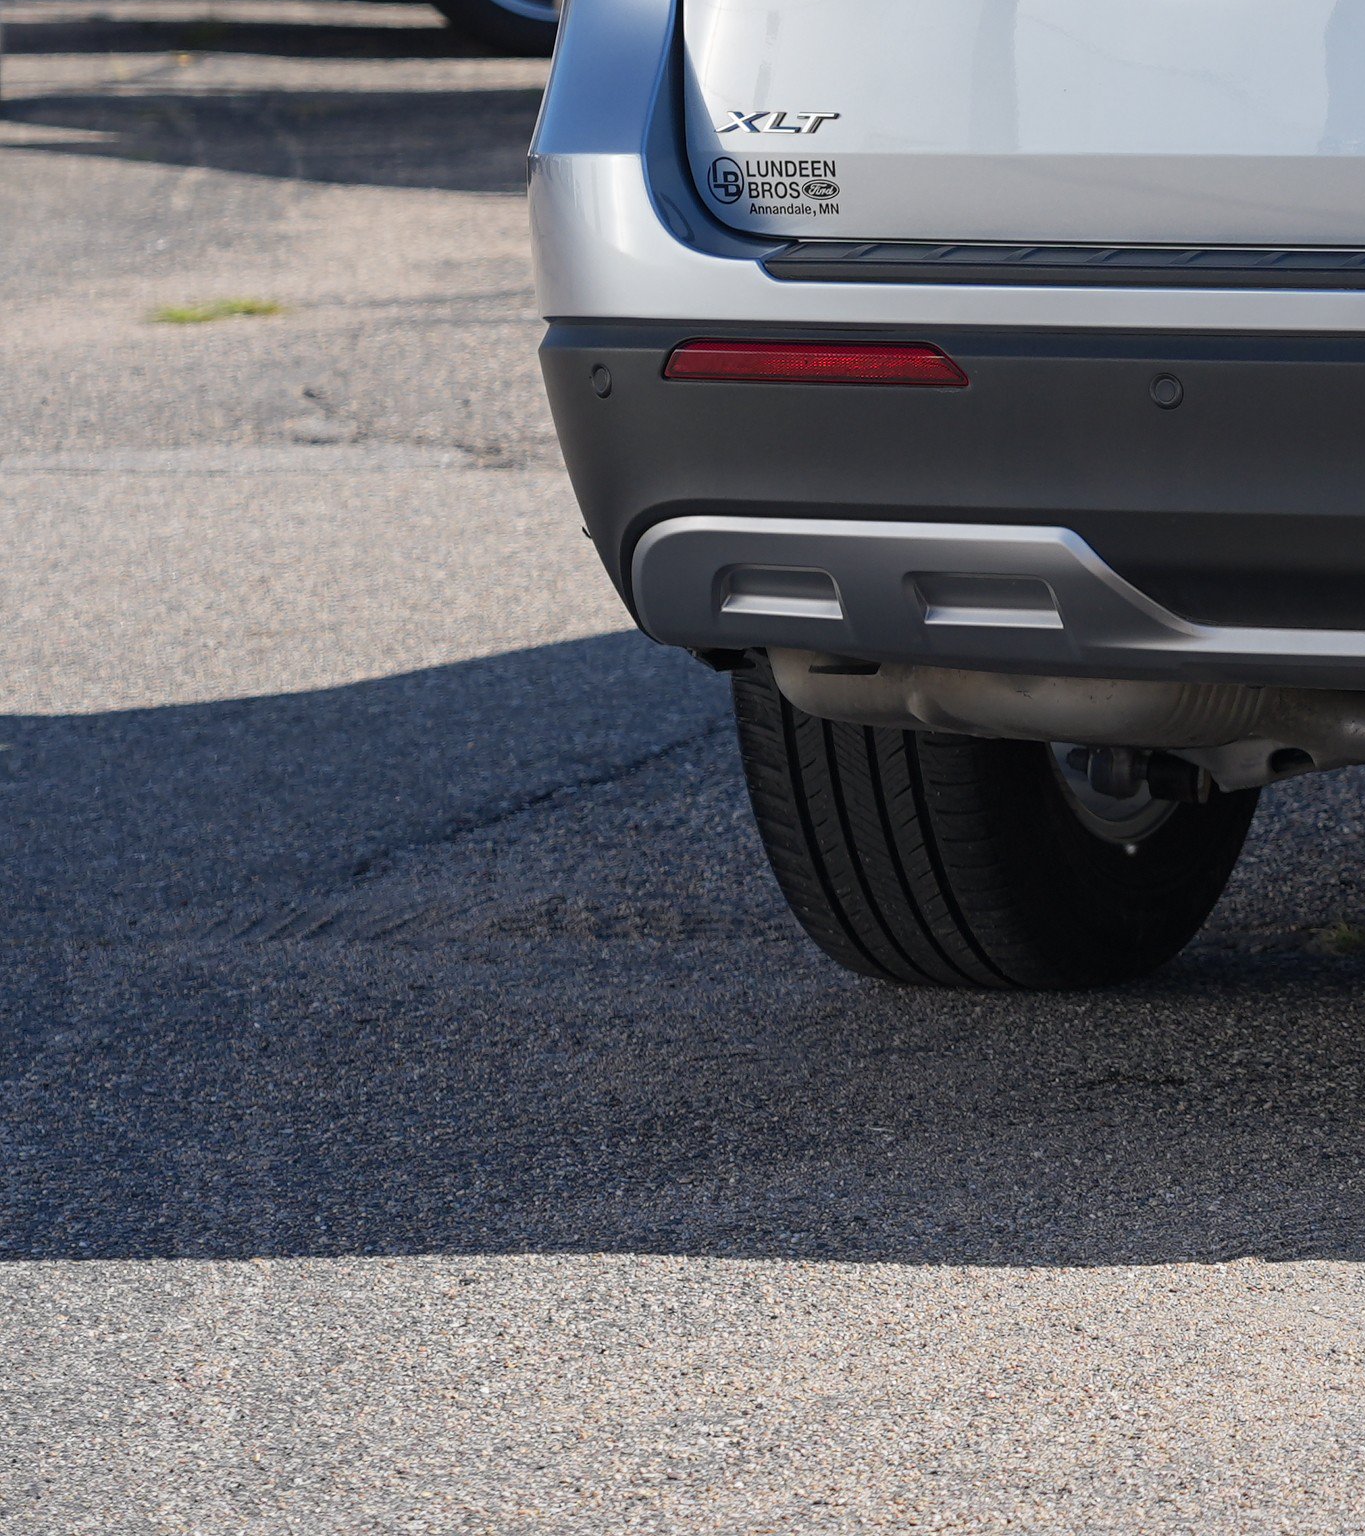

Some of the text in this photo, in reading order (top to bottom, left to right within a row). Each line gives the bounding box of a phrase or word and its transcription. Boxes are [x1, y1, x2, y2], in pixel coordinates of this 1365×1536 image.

[714, 111, 842, 134] XLT
[745, 160, 837, 178] LUNDEEN
[748, 181, 801, 199] BROS
[749, 203, 840, 217] Annandale, MN
